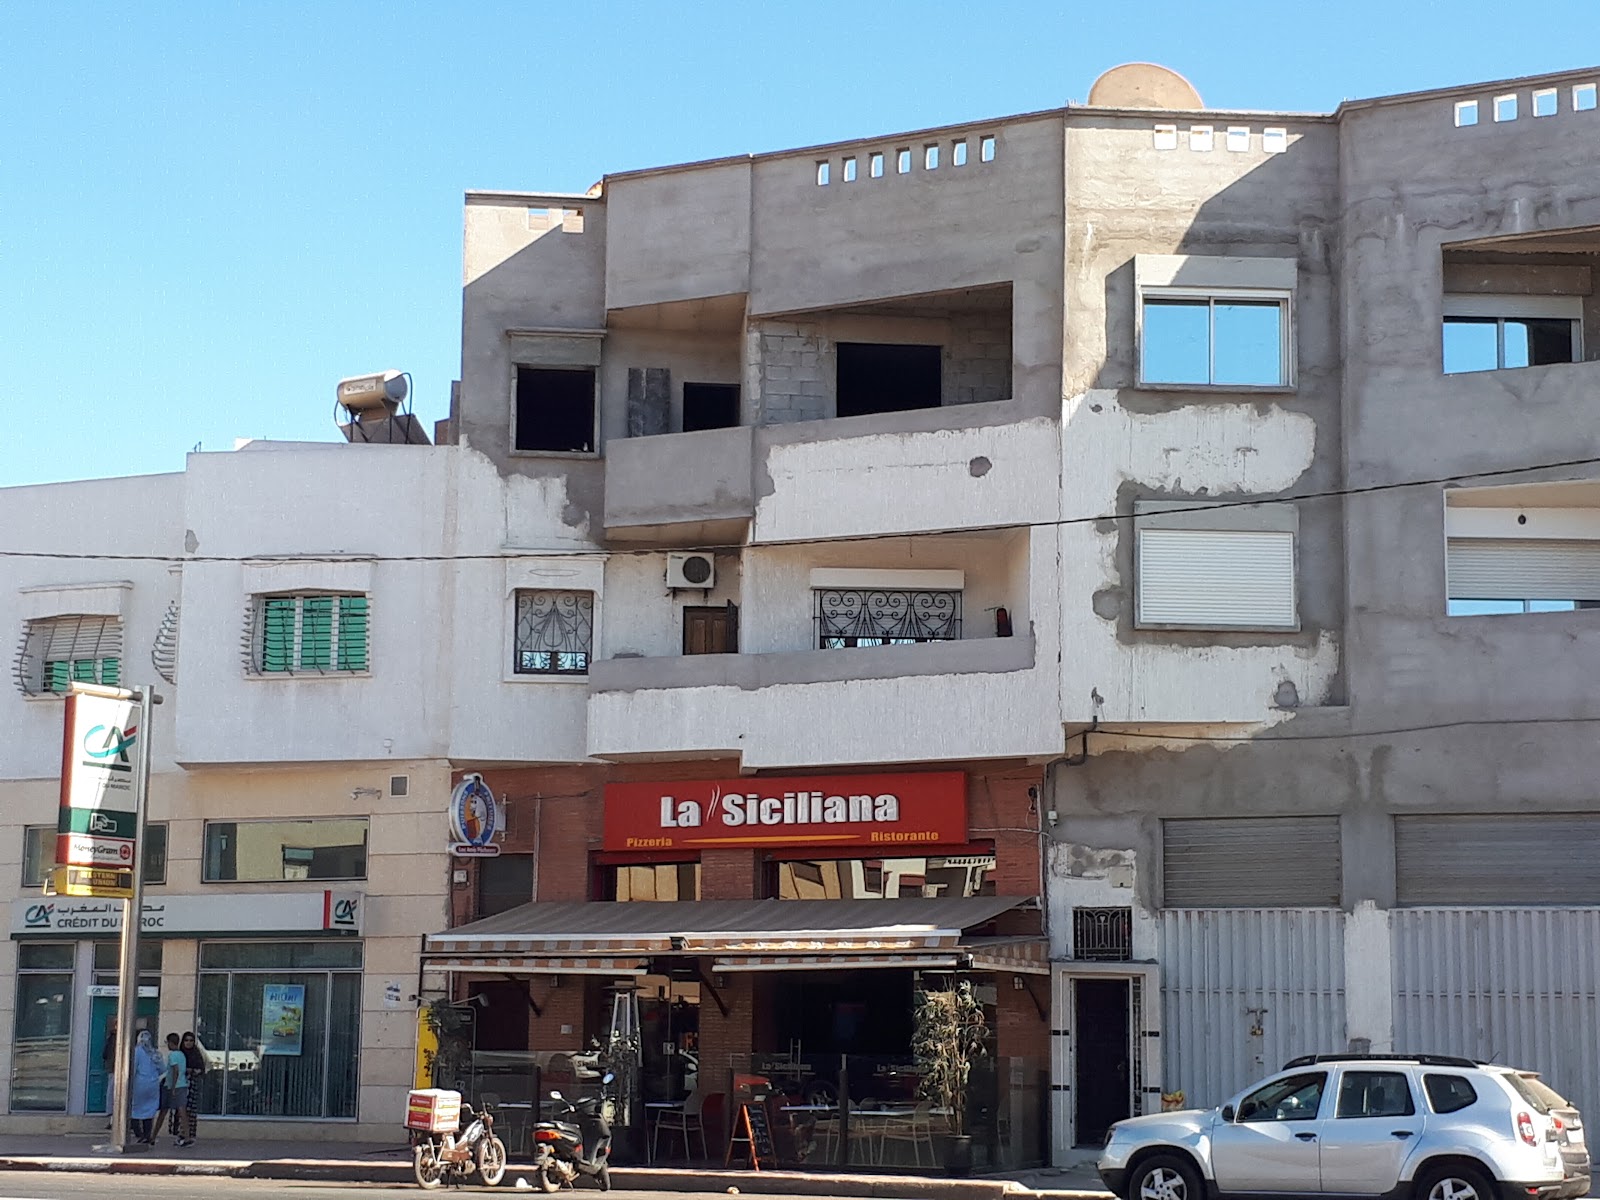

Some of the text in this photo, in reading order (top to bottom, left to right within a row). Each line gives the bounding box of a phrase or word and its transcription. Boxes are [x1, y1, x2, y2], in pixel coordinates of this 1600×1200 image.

[660, 791, 899, 828] La Siciliana
[626, 837, 673, 848] Pizzeria
[870, 831, 939, 842] Ristorante
[73, 843, 118, 856] MoneyGram
[57, 903, 111, 916] المغرب
[57, 916, 99, 928] CRÉDIT
[101, 918, 118, 928] DU
